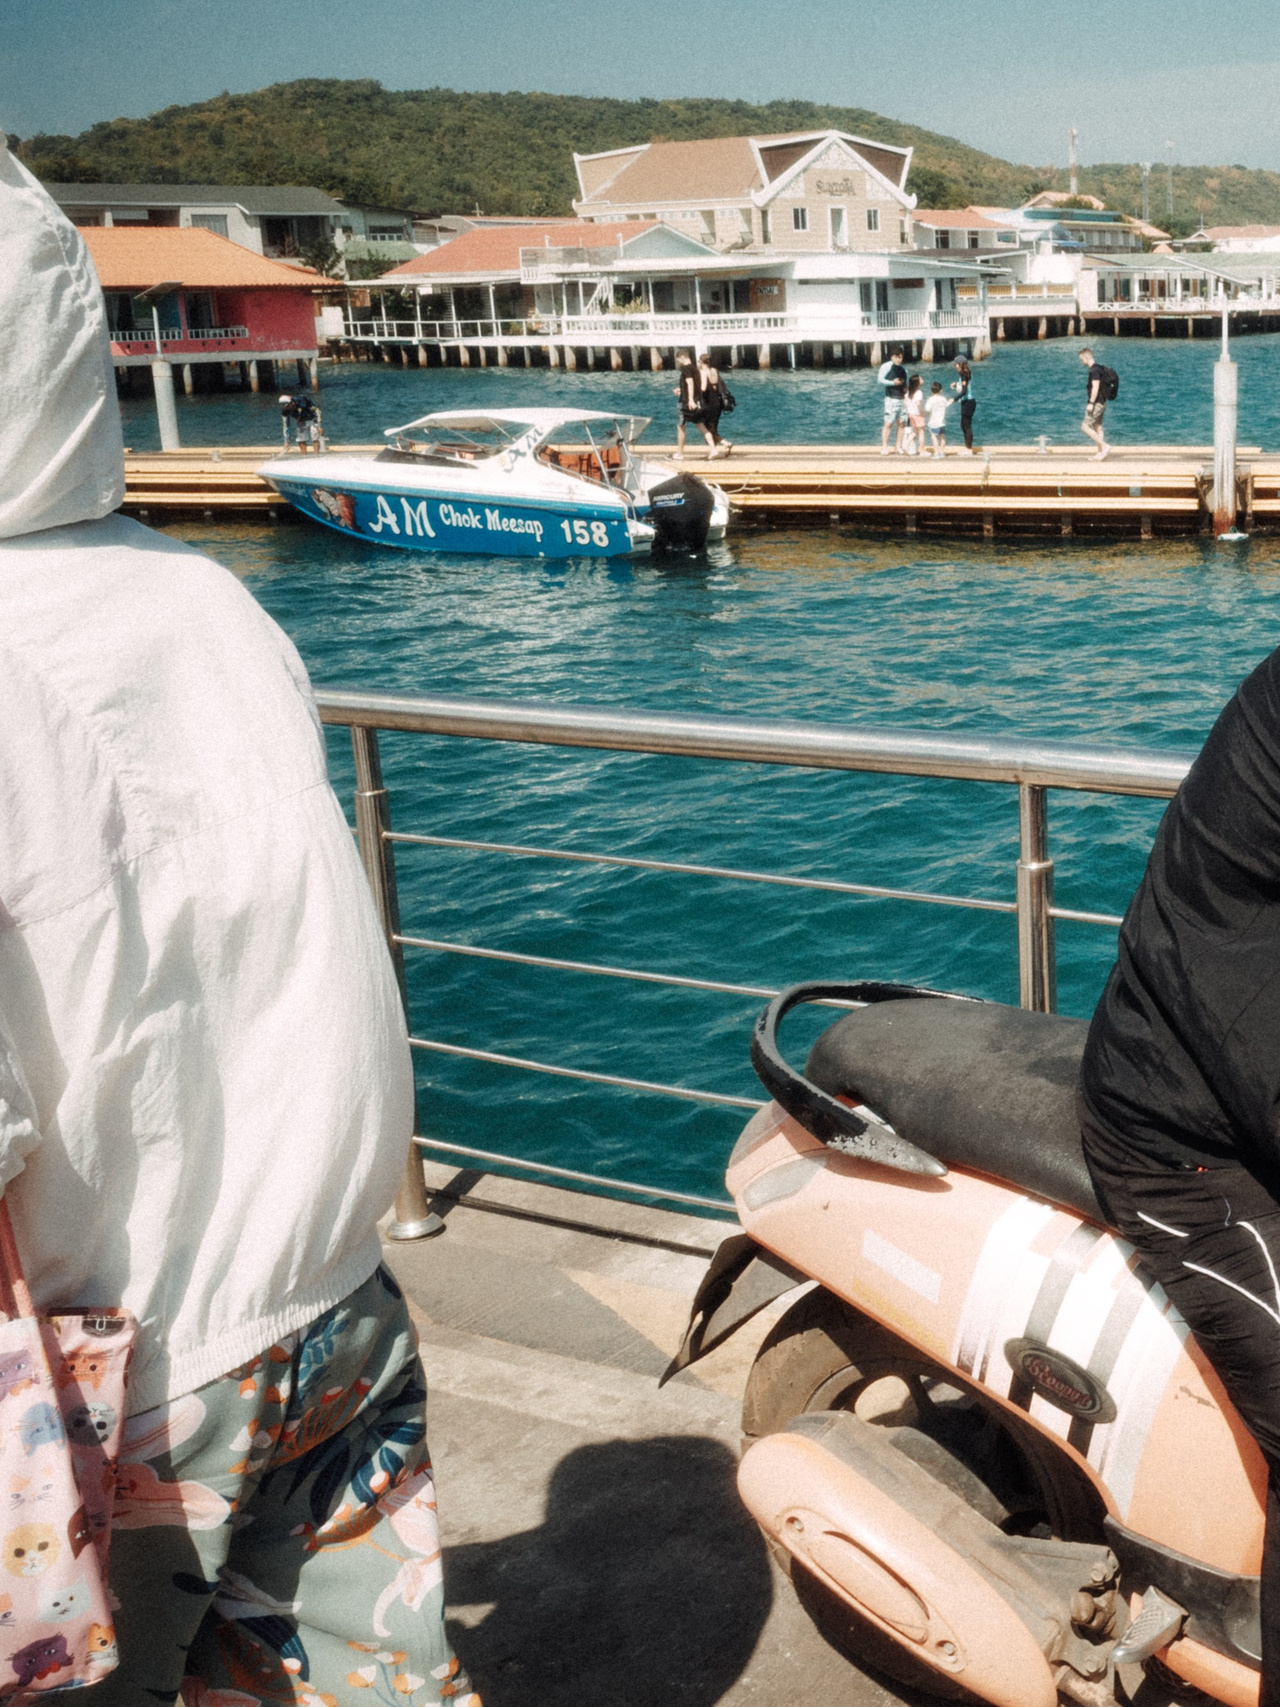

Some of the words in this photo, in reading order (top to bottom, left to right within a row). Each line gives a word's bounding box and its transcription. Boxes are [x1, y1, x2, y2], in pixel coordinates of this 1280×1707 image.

[368, 494, 436, 538] AM
[439, 503, 483, 530] Chok
[484, 508, 543, 543] Meesap
[560, 518, 610, 548] 158
